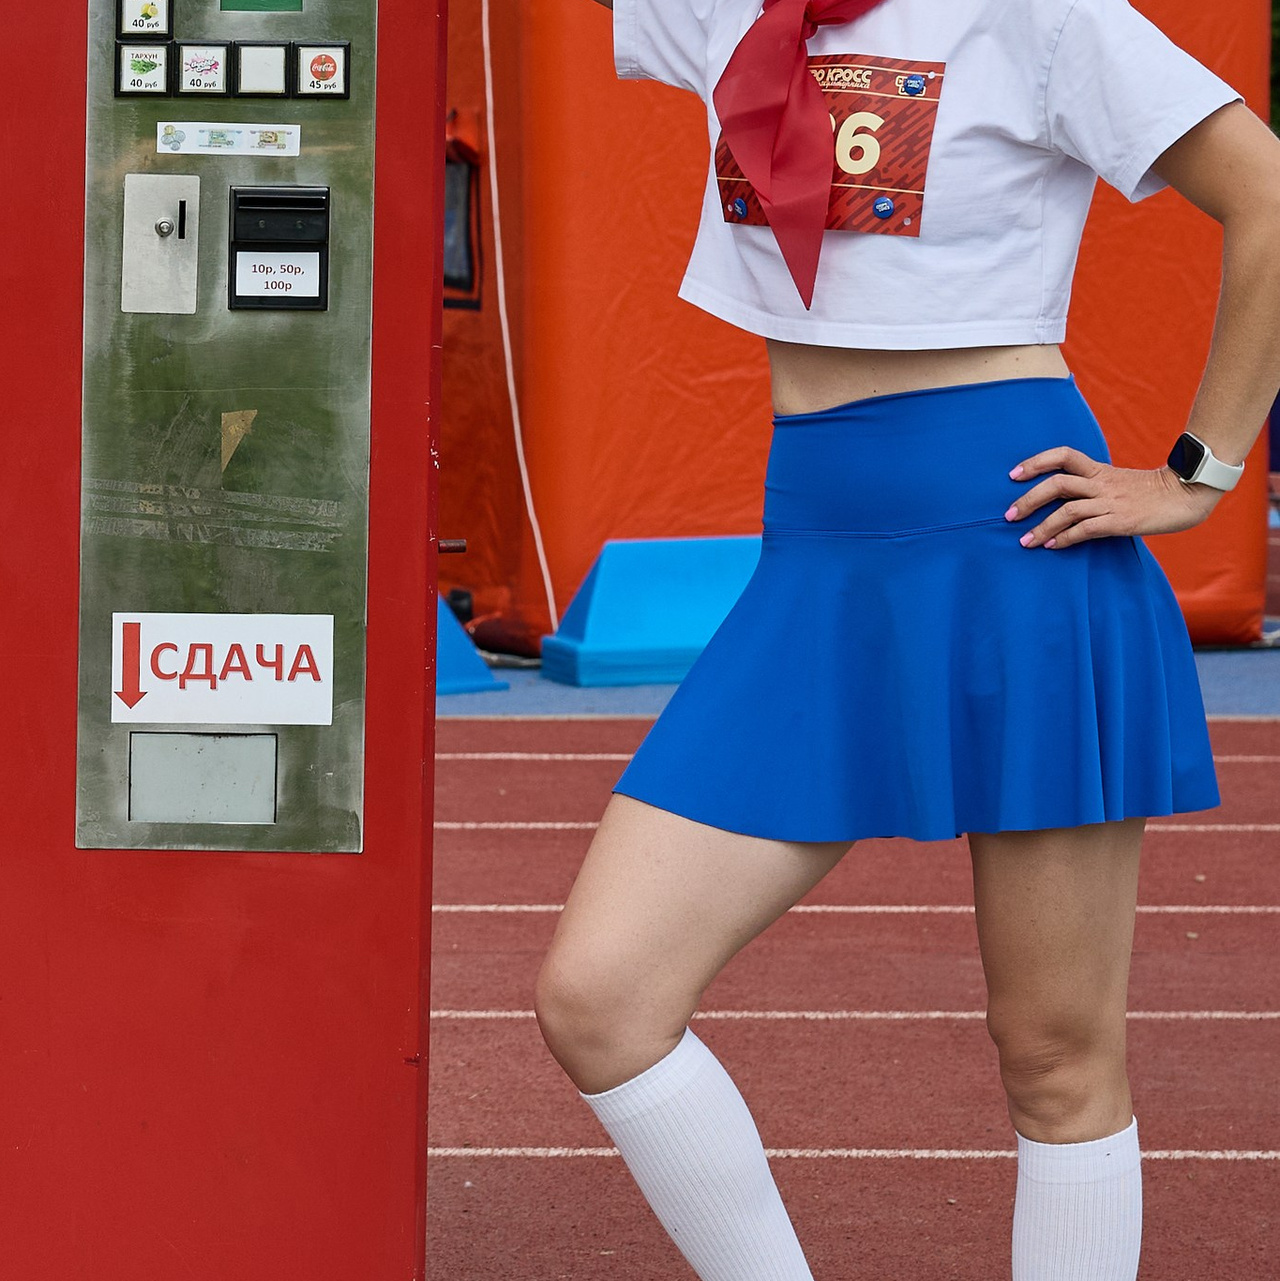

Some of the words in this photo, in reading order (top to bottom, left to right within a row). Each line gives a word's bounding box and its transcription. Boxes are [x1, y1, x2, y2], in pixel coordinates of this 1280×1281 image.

[132, 19, 144, 27] 40
[826, 68, 873, 84] КРОСС
[130, 79, 143, 87] 40
[189, 79, 201, 87] 40
[310, 81, 321, 89] 45
[830, 112, 885, 174] 6
[264, 280, 292, 291] 100р
[150, 641, 322, 689] СДАЧА
